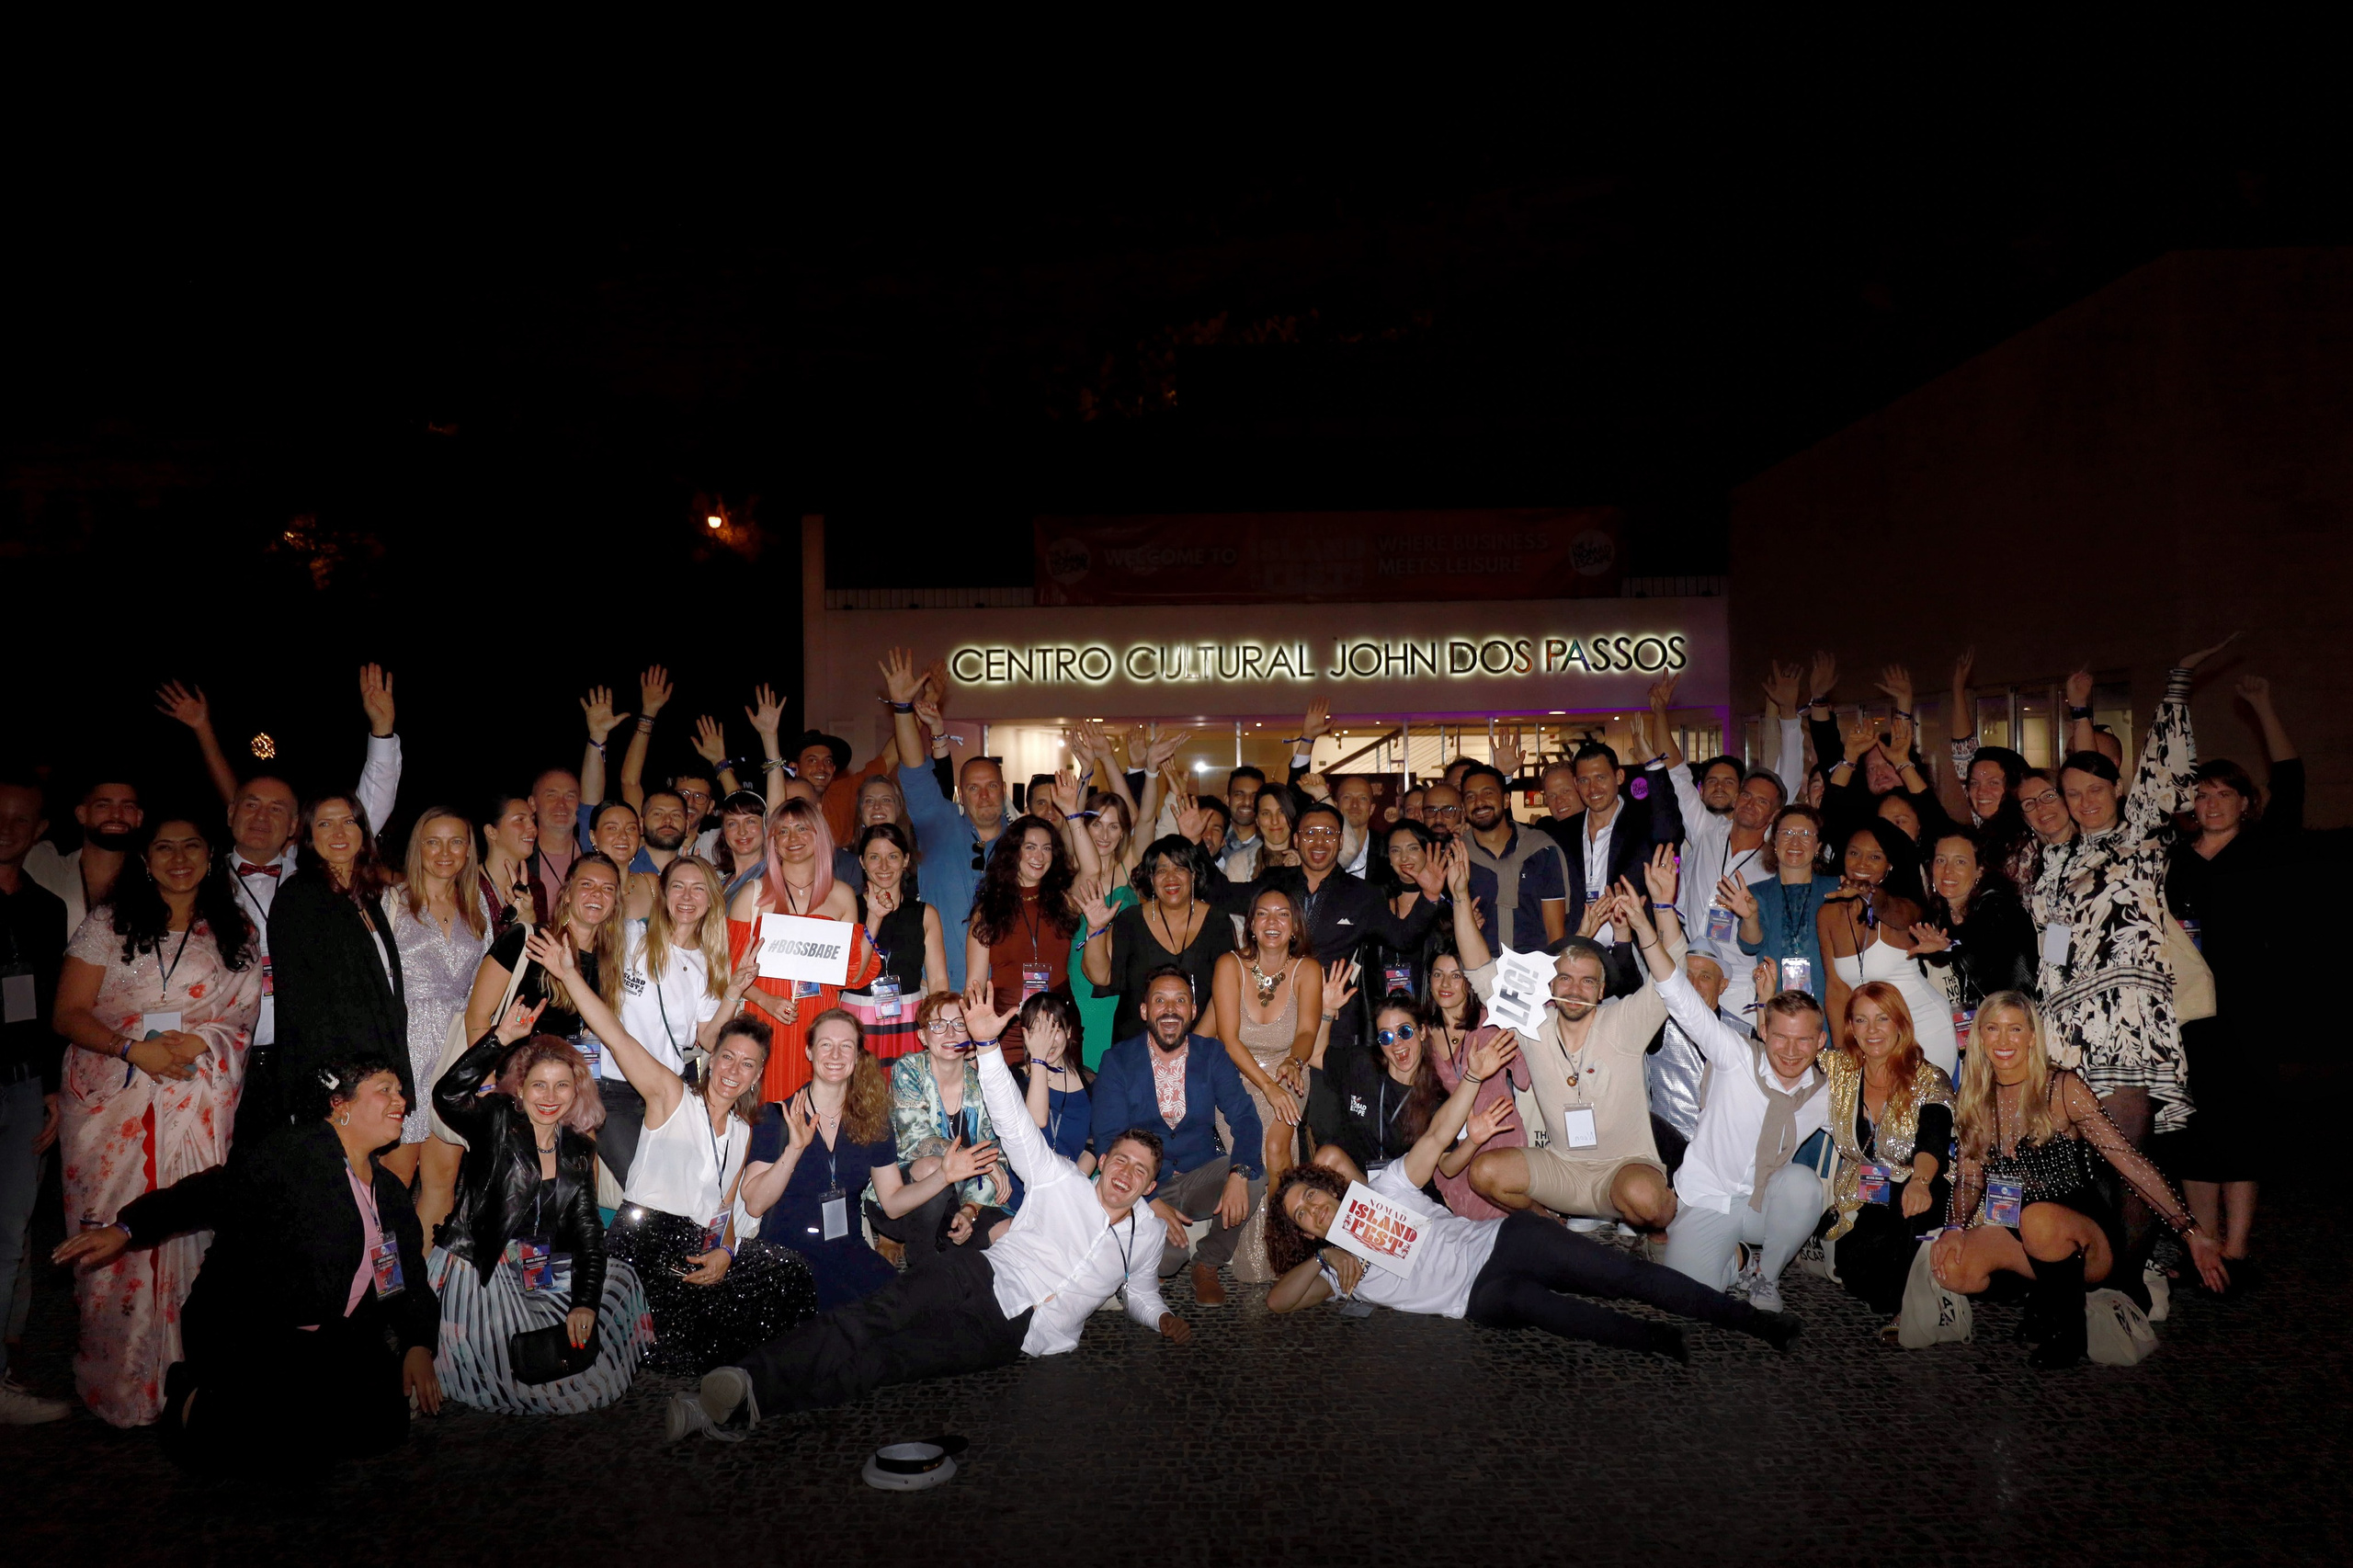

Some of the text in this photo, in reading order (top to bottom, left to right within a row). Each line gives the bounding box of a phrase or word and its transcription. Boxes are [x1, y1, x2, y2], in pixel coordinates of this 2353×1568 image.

[1378, 533, 1549, 552] WHERE BUSINESS
[1103, 547, 1237, 566] WELCOME TO
[1378, 556, 1522, 574] MEETS LEISURE
[951, 635, 1688, 682] CENTRO CULTURAL JOHN DOS PASSOS
[767, 939, 841, 960] #BOSSBABE
[624, 972, 646, 985] SLAND
[1495, 958, 1540, 1027] LFG!
[1348, 1198, 1418, 1243] ISLAND
[1369, 1198, 1407, 1222] NOMAD
[1350, 1217, 1404, 1254] FEST
